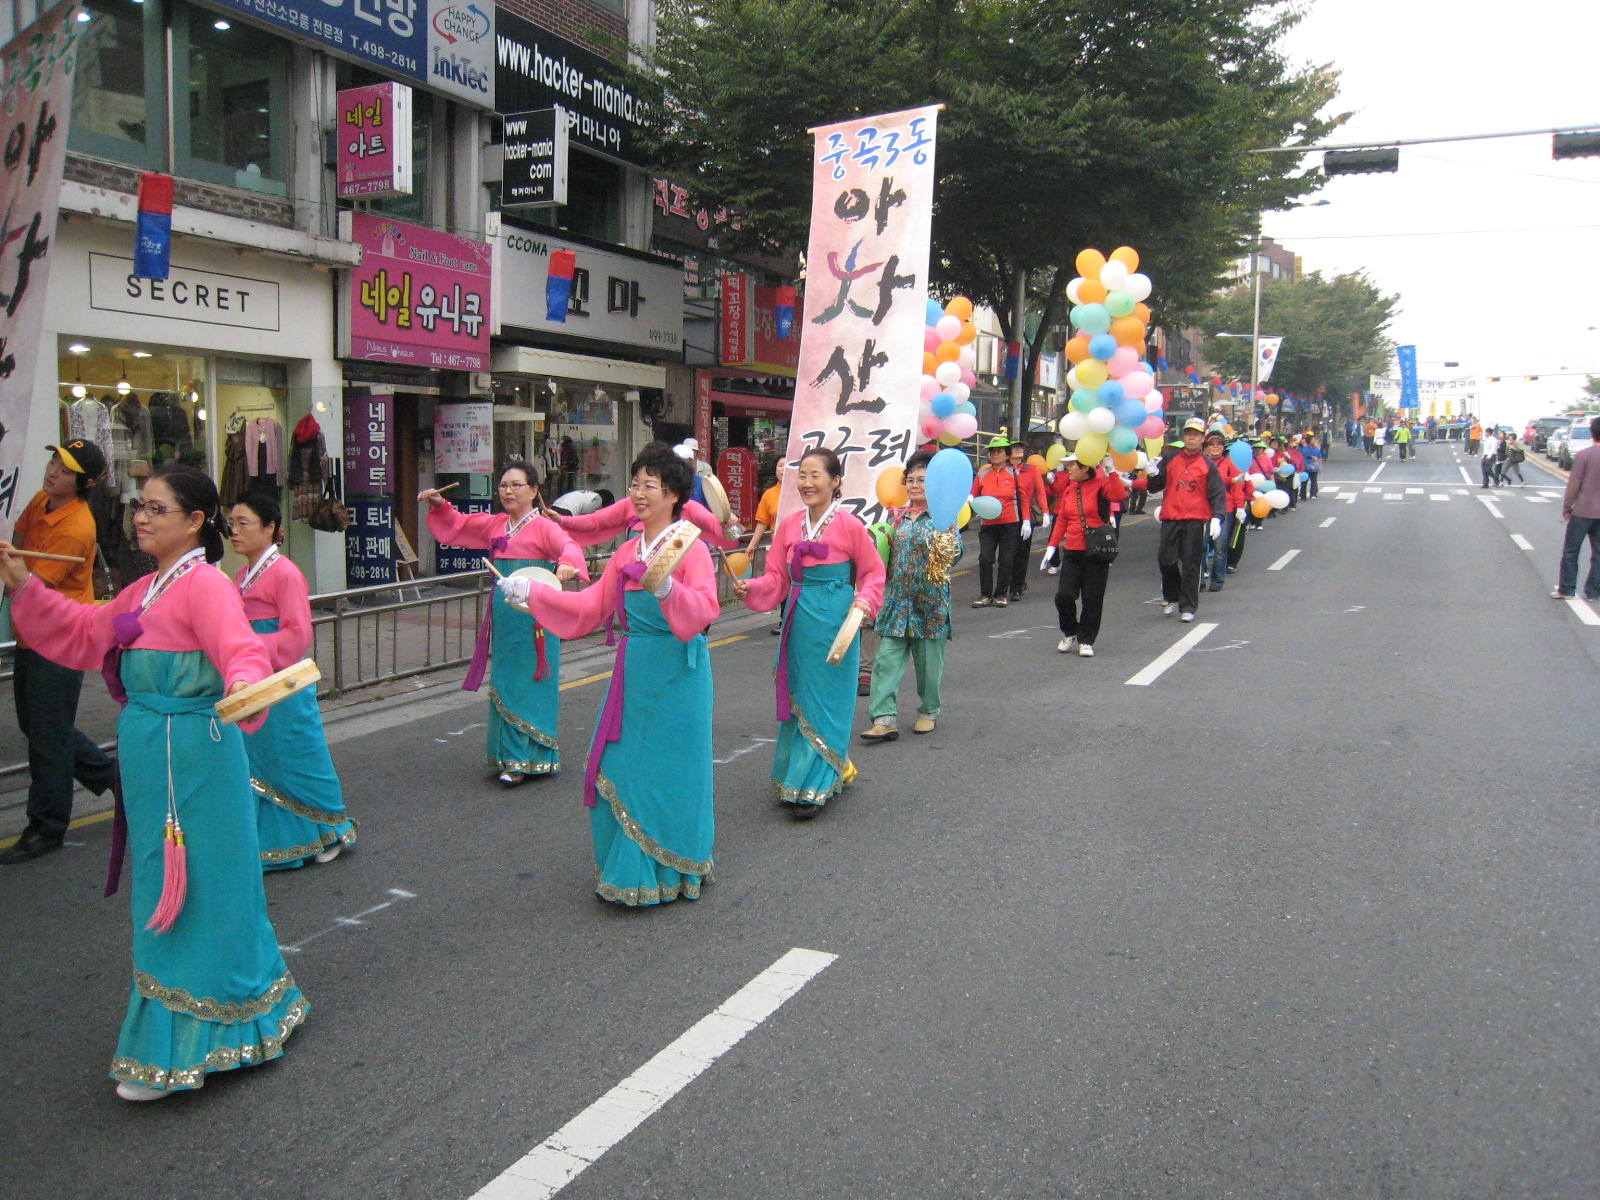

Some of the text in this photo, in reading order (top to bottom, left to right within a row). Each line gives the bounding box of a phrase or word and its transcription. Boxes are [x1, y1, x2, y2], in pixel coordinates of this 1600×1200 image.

[444, 19, 480, 44] CHANGE
[448, 8, 476, 28] HAPPY
[313, 18, 343, 44] 전문점
[351, 35, 417, 72] T.498-2814
[433, 46, 488, 93] InkTec
[497, 34, 660, 127] www.hacker-mania.co
[346, 98, 382, 128] 네일
[554, 103, 621, 151] 커마니아
[505, 121, 527, 136] www
[348, 132, 386, 159] 아트
[505, 138, 553, 160] hacker-mania
[819, 117, 933, 180] 중곡3동
[530, 163, 552, 179] com
[343, 180, 390, 195] 467-7798
[409, 247, 428, 260] Nail
[431, 252, 438, 263] &
[507, 235, 548, 257] CCOMA
[126, 274, 250, 313] SECRET
[361, 269, 484, 340] 네일 유니큐
[809, 176, 915, 415] 아차산
[368, 402, 388, 486] 네일아트
[366, 505, 392, 529] 토너
